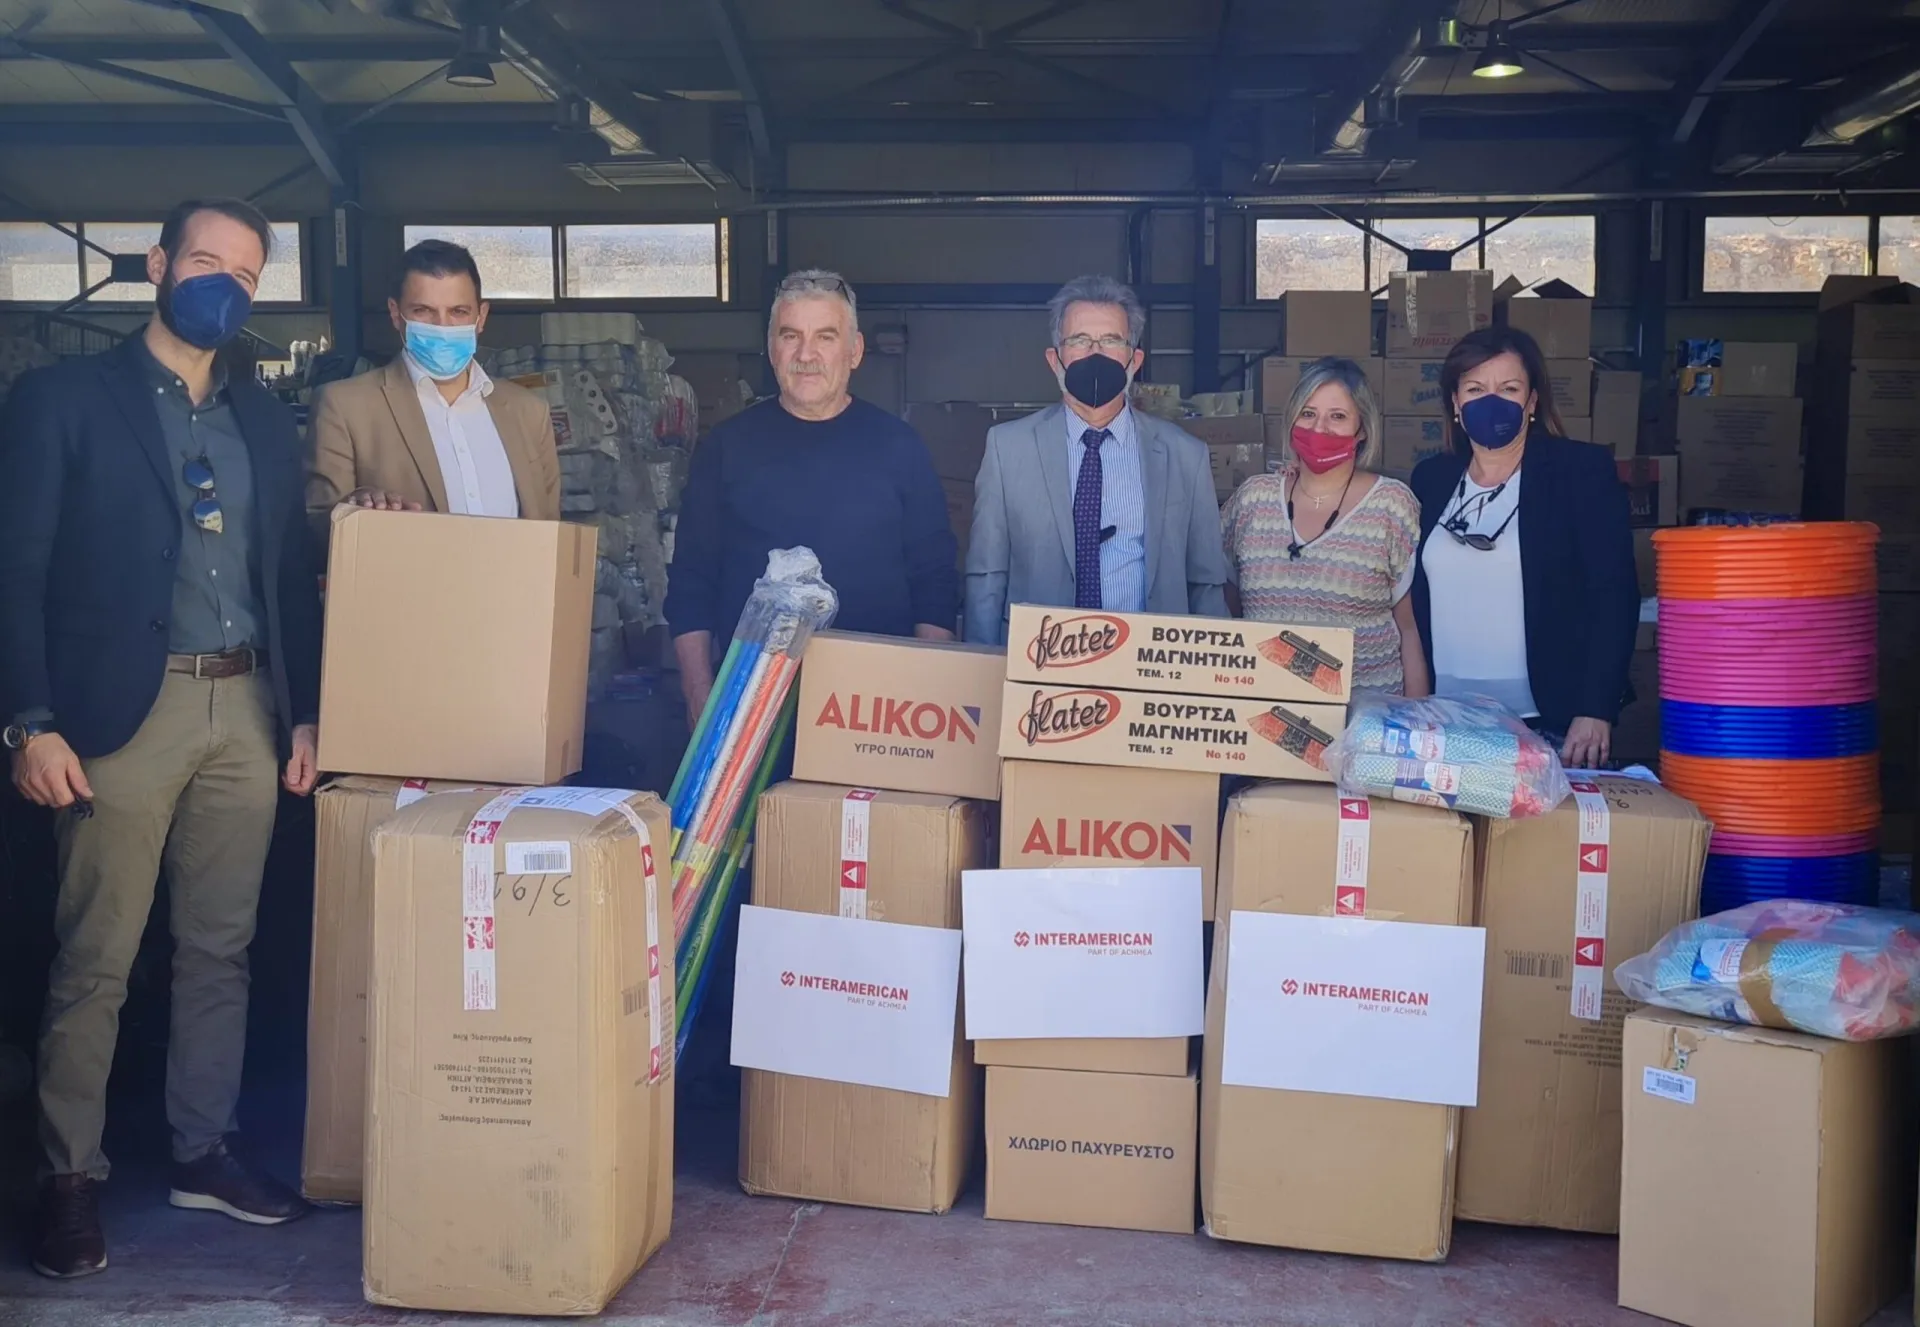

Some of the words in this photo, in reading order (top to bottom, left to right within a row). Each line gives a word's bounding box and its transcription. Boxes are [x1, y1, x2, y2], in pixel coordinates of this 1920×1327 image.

[1034, 615, 1120, 672] flater
[1151, 626, 1246, 648] ΒΟΥΡΤΣΑ
[1136, 648, 1257, 670] ΜΑΓΝΗΤΙΚΗ
[1136, 669, 1165, 680] ΤΕΜ.
[1168, 671, 1182, 680] 12
[1214, 673, 1231, 685] No
[1233, 675, 1255, 686] 140
[815, 691, 981, 745] ALIKON
[1026, 690, 1113, 746] flater
[1143, 702, 1237, 724] ΒΟΥΡΤΣΑ
[1128, 722, 1249, 746] ΜΑΓΝΗΤΙΚΗ
[854, 743, 886, 756] ΥΓΡΟ
[889, 746, 934, 760] ΠΙΑΤΩΝ
[1128, 744, 1156, 754] ΤΕΜ.
[1159, 745, 1173, 756] 12
[1205, 749, 1222, 760] No
[1224, 750, 1246, 761] 140
[1021, 817, 1192, 862] ALIKON
[1034, 932, 1153, 946] INTERAMERICAN
[799, 974, 909, 1001] INTERAMERICAN
[1303, 982, 1429, 1006] INTERAMERICAN
[1358, 1003, 1379, 1012] PART
[1381, 1005, 1392, 1013] OF
[1008, 1136, 1067, 1152] ΧΛΩΡΙΟ
[1071, 1140, 1175, 1160] ΠΑΧΥΡΕΥΣΤΟ
